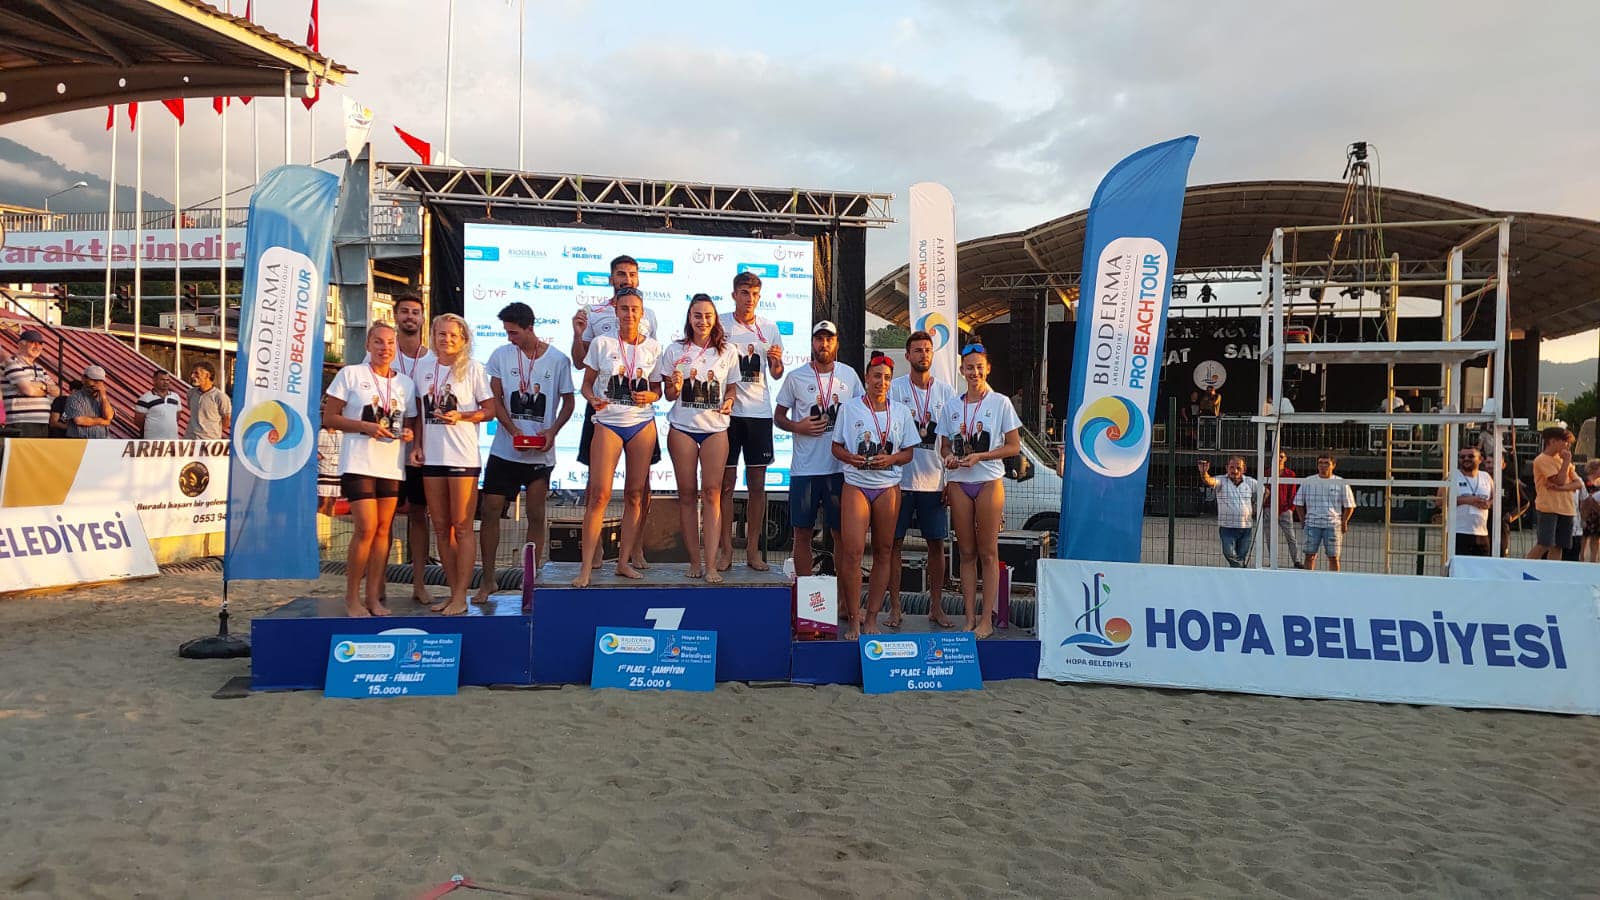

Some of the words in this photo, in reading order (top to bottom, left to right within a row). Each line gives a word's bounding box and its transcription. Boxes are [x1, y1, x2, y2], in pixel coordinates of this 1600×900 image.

[0, 235, 245, 263] arakterimdir.
[706, 253, 724, 262] TVF
[788, 250, 804, 259] TVF
[487, 289, 508, 298] TVF
[1093, 254, 1123, 386] BIODERMA
[1111, 332, 1123, 387] LABORATOIRE
[1118, 254, 1131, 329] DERMATOLOGIQUE
[1129, 254, 1161, 389] PROBEACHTOUR
[254, 263, 281, 389] BIODERMA
[287, 269, 312, 394] PROBEACHTOUR
[121, 440, 196, 458] ARHAVI
[649, 471, 673, 481] TVF
[136, 502, 166, 511] Burada
[193, 514, 215, 524] 0553
[1145, 607, 1275, 656] HOPA
[1282, 610, 1567, 670] BELEDİYESİ
[1088, 659, 1131, 668] BELEDİYESİ
[626, 665, 646, 673] PLACE
[900, 668, 921, 677] PLACE
[926, 665, 954, 678] ÜÇÜNCÜ
[365, 673, 388, 682] PLACE
[629, 677, 665, 688] 25.000
[907, 680, 935, 689] 6.000
[368, 685, 401, 695] 15.000
